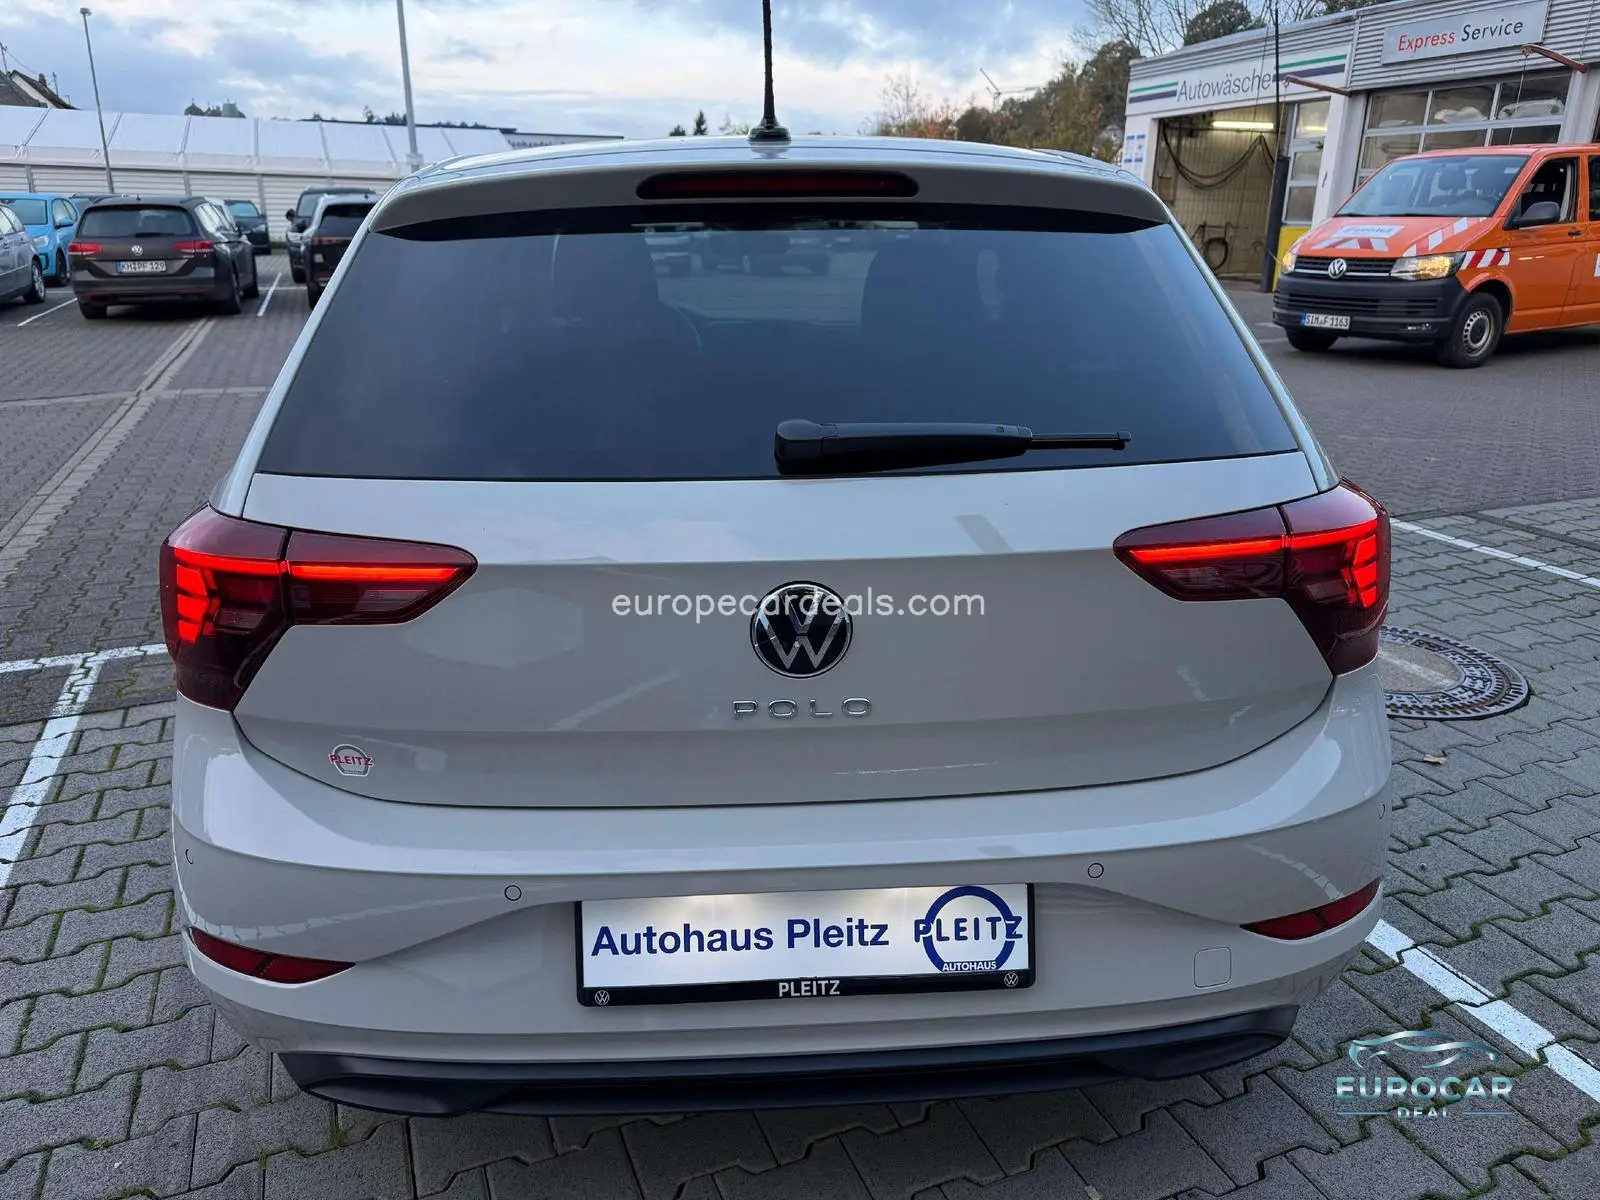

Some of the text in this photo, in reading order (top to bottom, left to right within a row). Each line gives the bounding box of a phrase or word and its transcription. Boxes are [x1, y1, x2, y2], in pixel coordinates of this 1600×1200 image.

[1398, 18, 1524, 52] Express Service
[1177, 67, 1272, 102] Autowäsche
[732, 697, 873, 720] POLO
[329, 754, 373, 767] PLEITZ
[591, 918, 889, 957] Autohaus Pleitz
[914, 915, 1024, 943] PLEITZ
[940, 960, 998, 973] AUTOHAUS
[778, 979, 841, 998] PLEITZ
